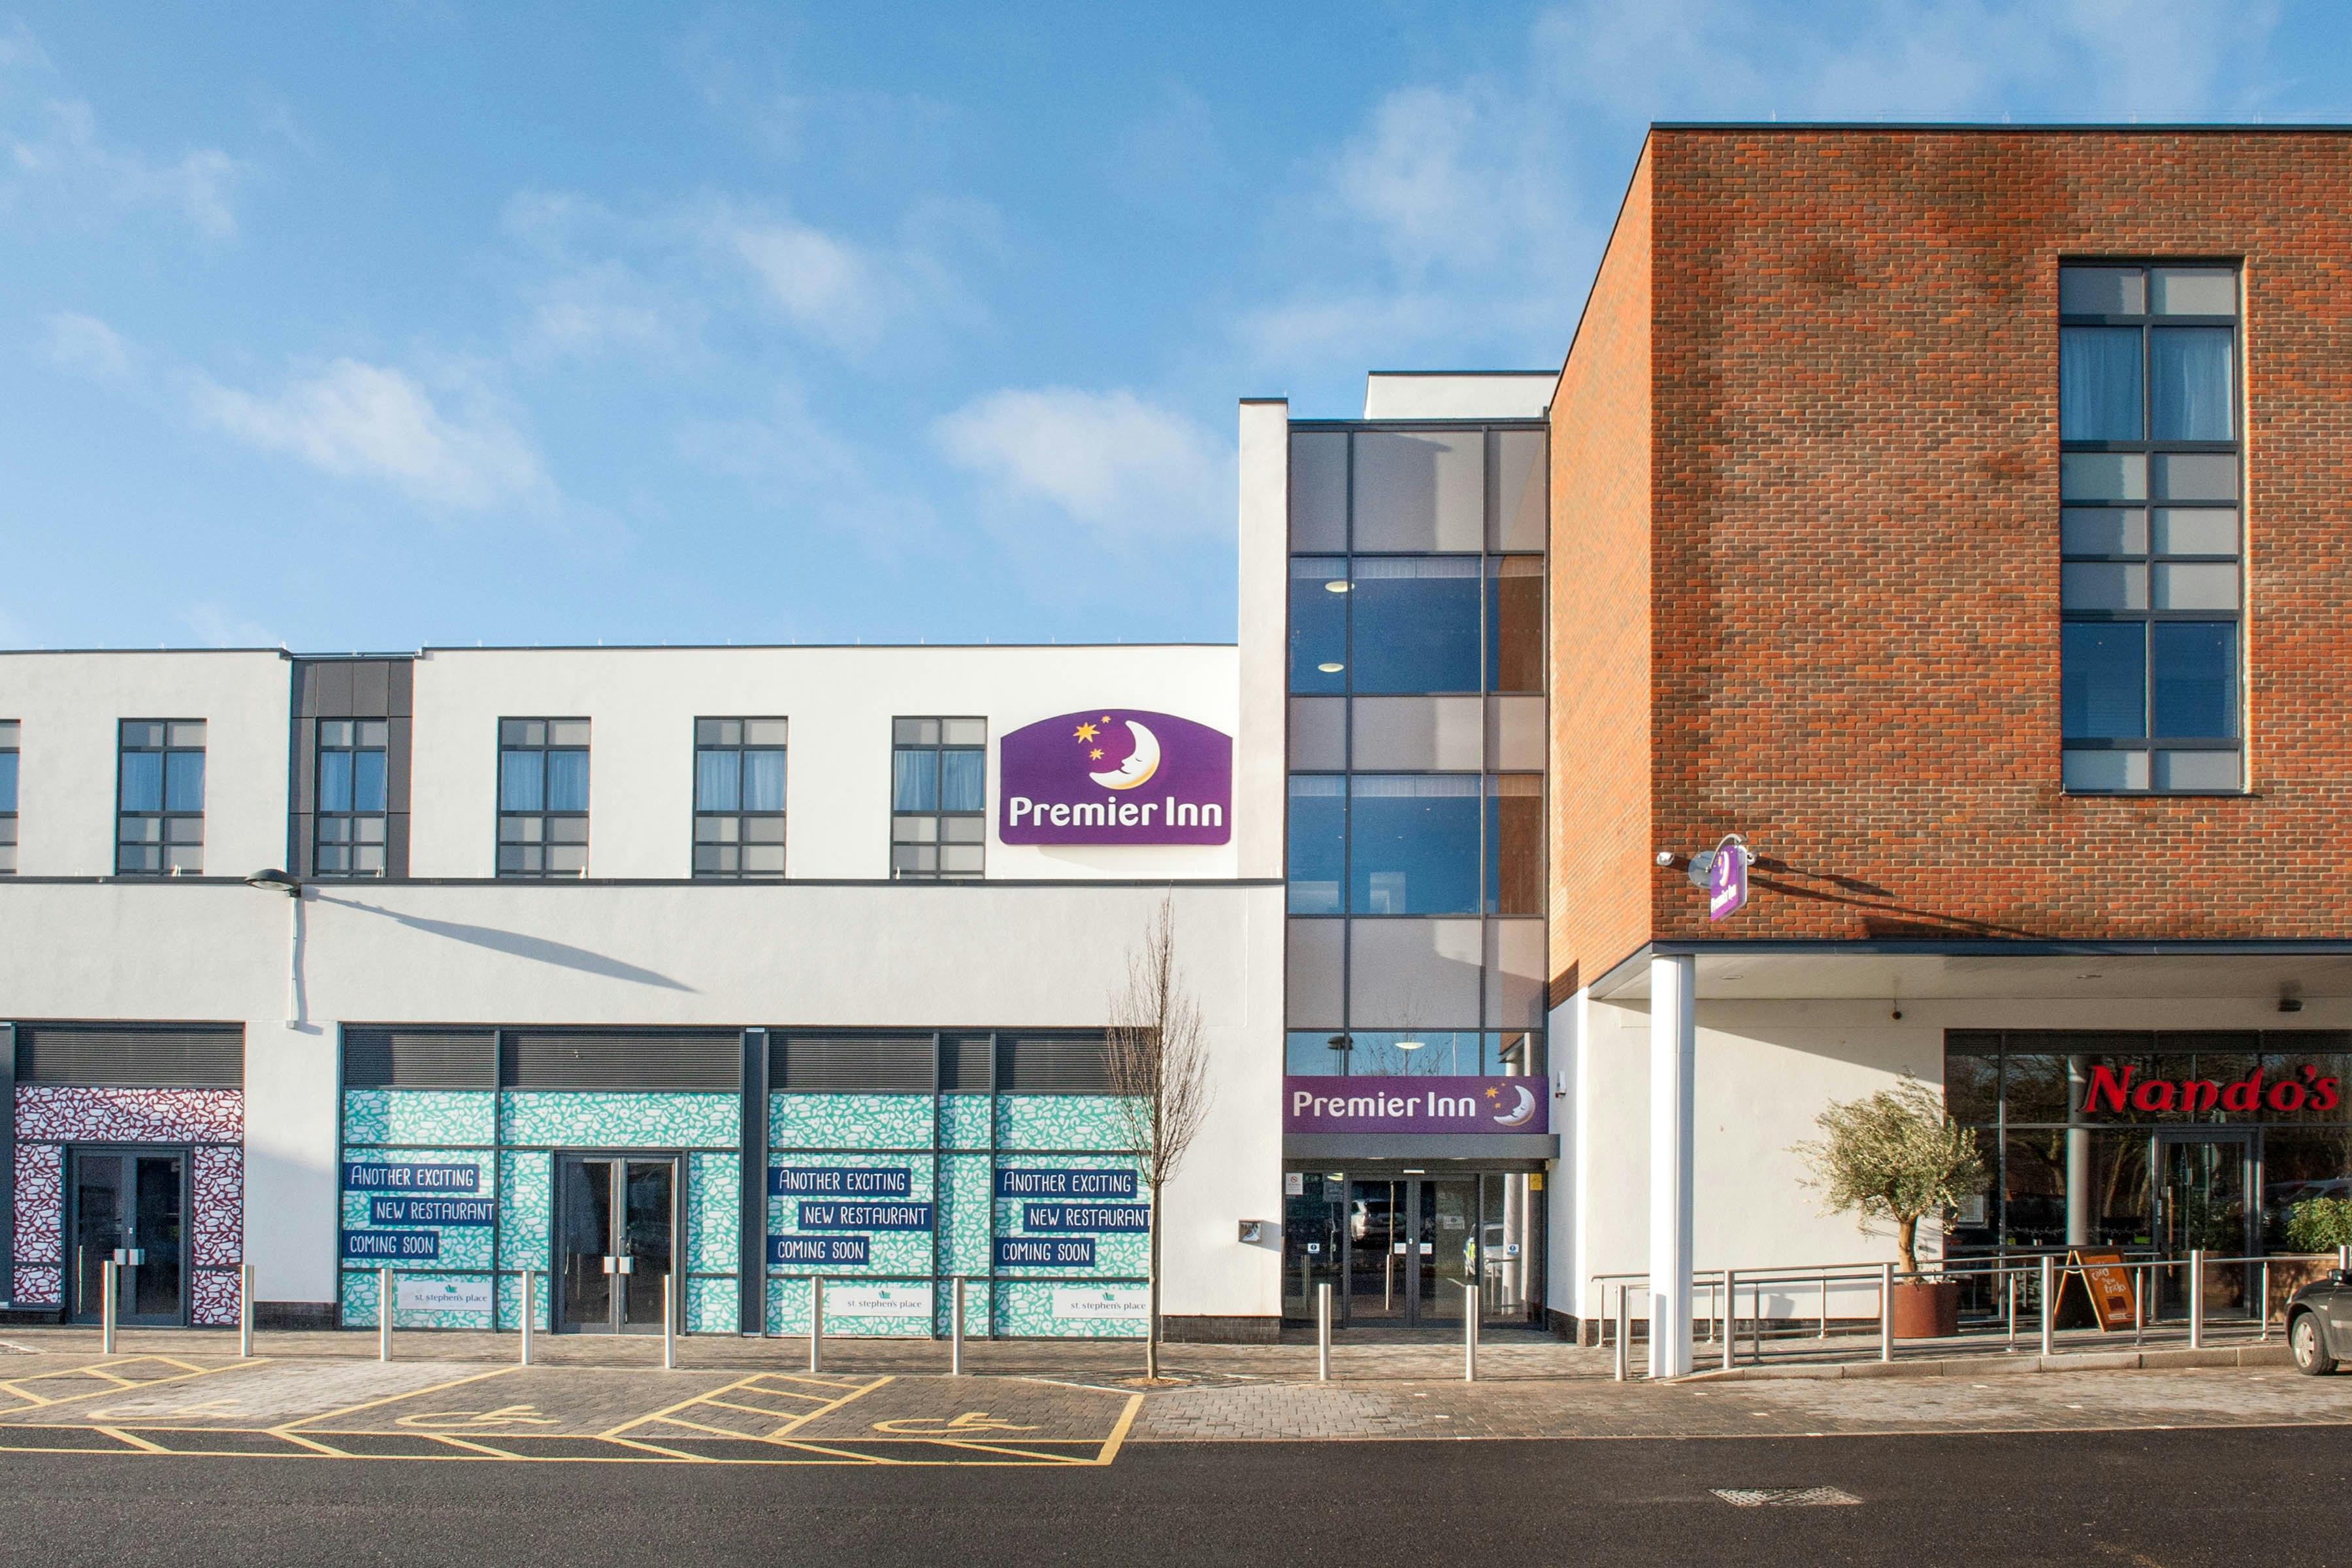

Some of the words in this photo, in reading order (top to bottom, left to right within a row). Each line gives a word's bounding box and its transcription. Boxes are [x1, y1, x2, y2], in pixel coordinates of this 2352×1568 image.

[1009, 796, 1158, 826] Premier
[1166, 796, 1222, 826] Inn
[2084, 1065, 2339, 1113] Nando's
[1294, 1092, 1421, 1117] Premier
[1428, 1092, 1476, 1117] Inn
[351, 1166, 411, 1185] ANOTHER
[417, 1169, 474, 1186] EXCITING
[779, 1169, 840, 1190] ANOTHER
[847, 1173, 905, 1190] EXCITING
[1004, 1171, 1066, 1192] ANOTHER
[1072, 1175, 1131, 1192] EXCITING
[376, 1201, 405, 1219] NEW
[411, 1202, 494, 1220] RESTAURANT
[805, 1207, 834, 1224] NEW
[840, 1207, 928, 1224] RESTAURANT
[1030, 1208, 1059, 1226] NEW
[1066, 1209, 1151, 1226] RESTAURANT
[350, 1235, 397, 1253] COMING
[402, 1237, 433, 1253] SOON
[777, 1241, 825, 1259] COMING
[832, 1241, 864, 1259] SOON
[1003, 1243, 1051, 1261] COMING
[1058, 1243, 1090, 1261] SOON
[466, 1294, 488, 1303] place
[859, 1300, 897, 1309] stephen's
[900, 1300, 922, 1309] place
[1082, 1302, 1122, 1311] stephen's
[1124, 1302, 1147, 1311] place
